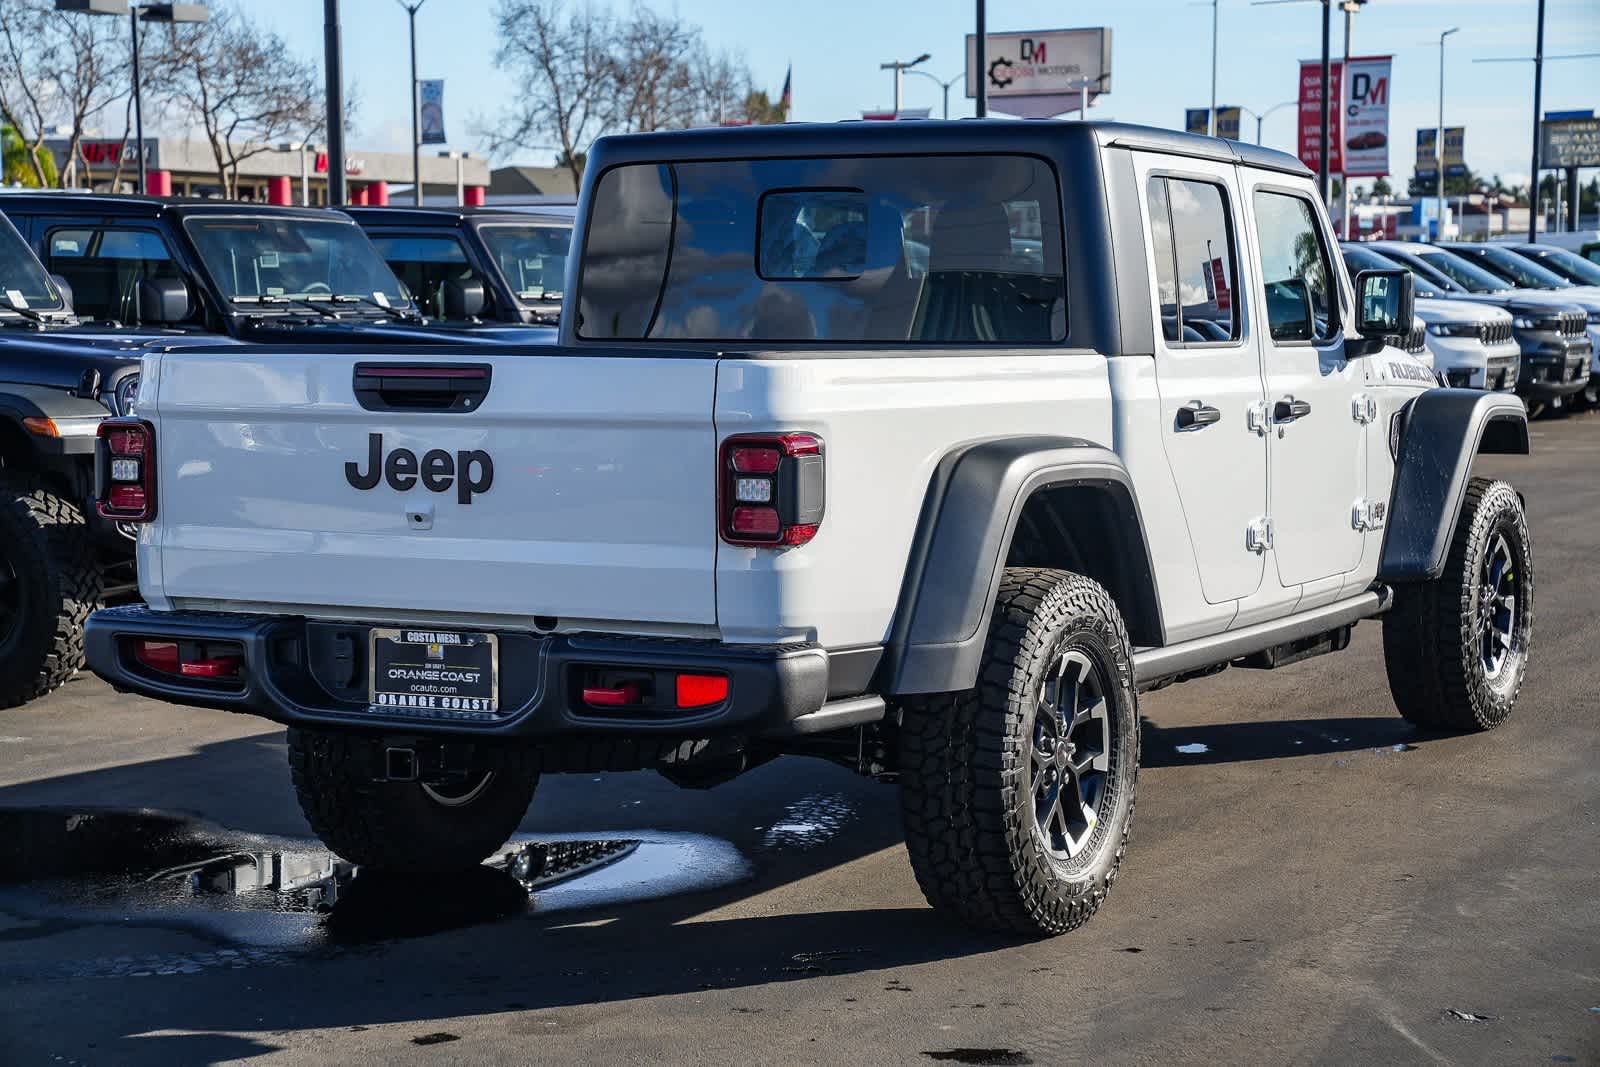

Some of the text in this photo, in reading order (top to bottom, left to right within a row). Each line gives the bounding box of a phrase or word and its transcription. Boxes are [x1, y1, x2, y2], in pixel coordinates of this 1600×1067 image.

[1021, 39, 1046, 64] DM
[1352, 73, 1387, 105] DM
[345, 433, 494, 504] Jeep
[407, 631, 461, 644] COSTA MESA
[388, 669, 481, 683] ORANGE COAST
[410, 684, 457, 694] ocauto.com
[379, 694, 489, 710] ORANGE COAST
